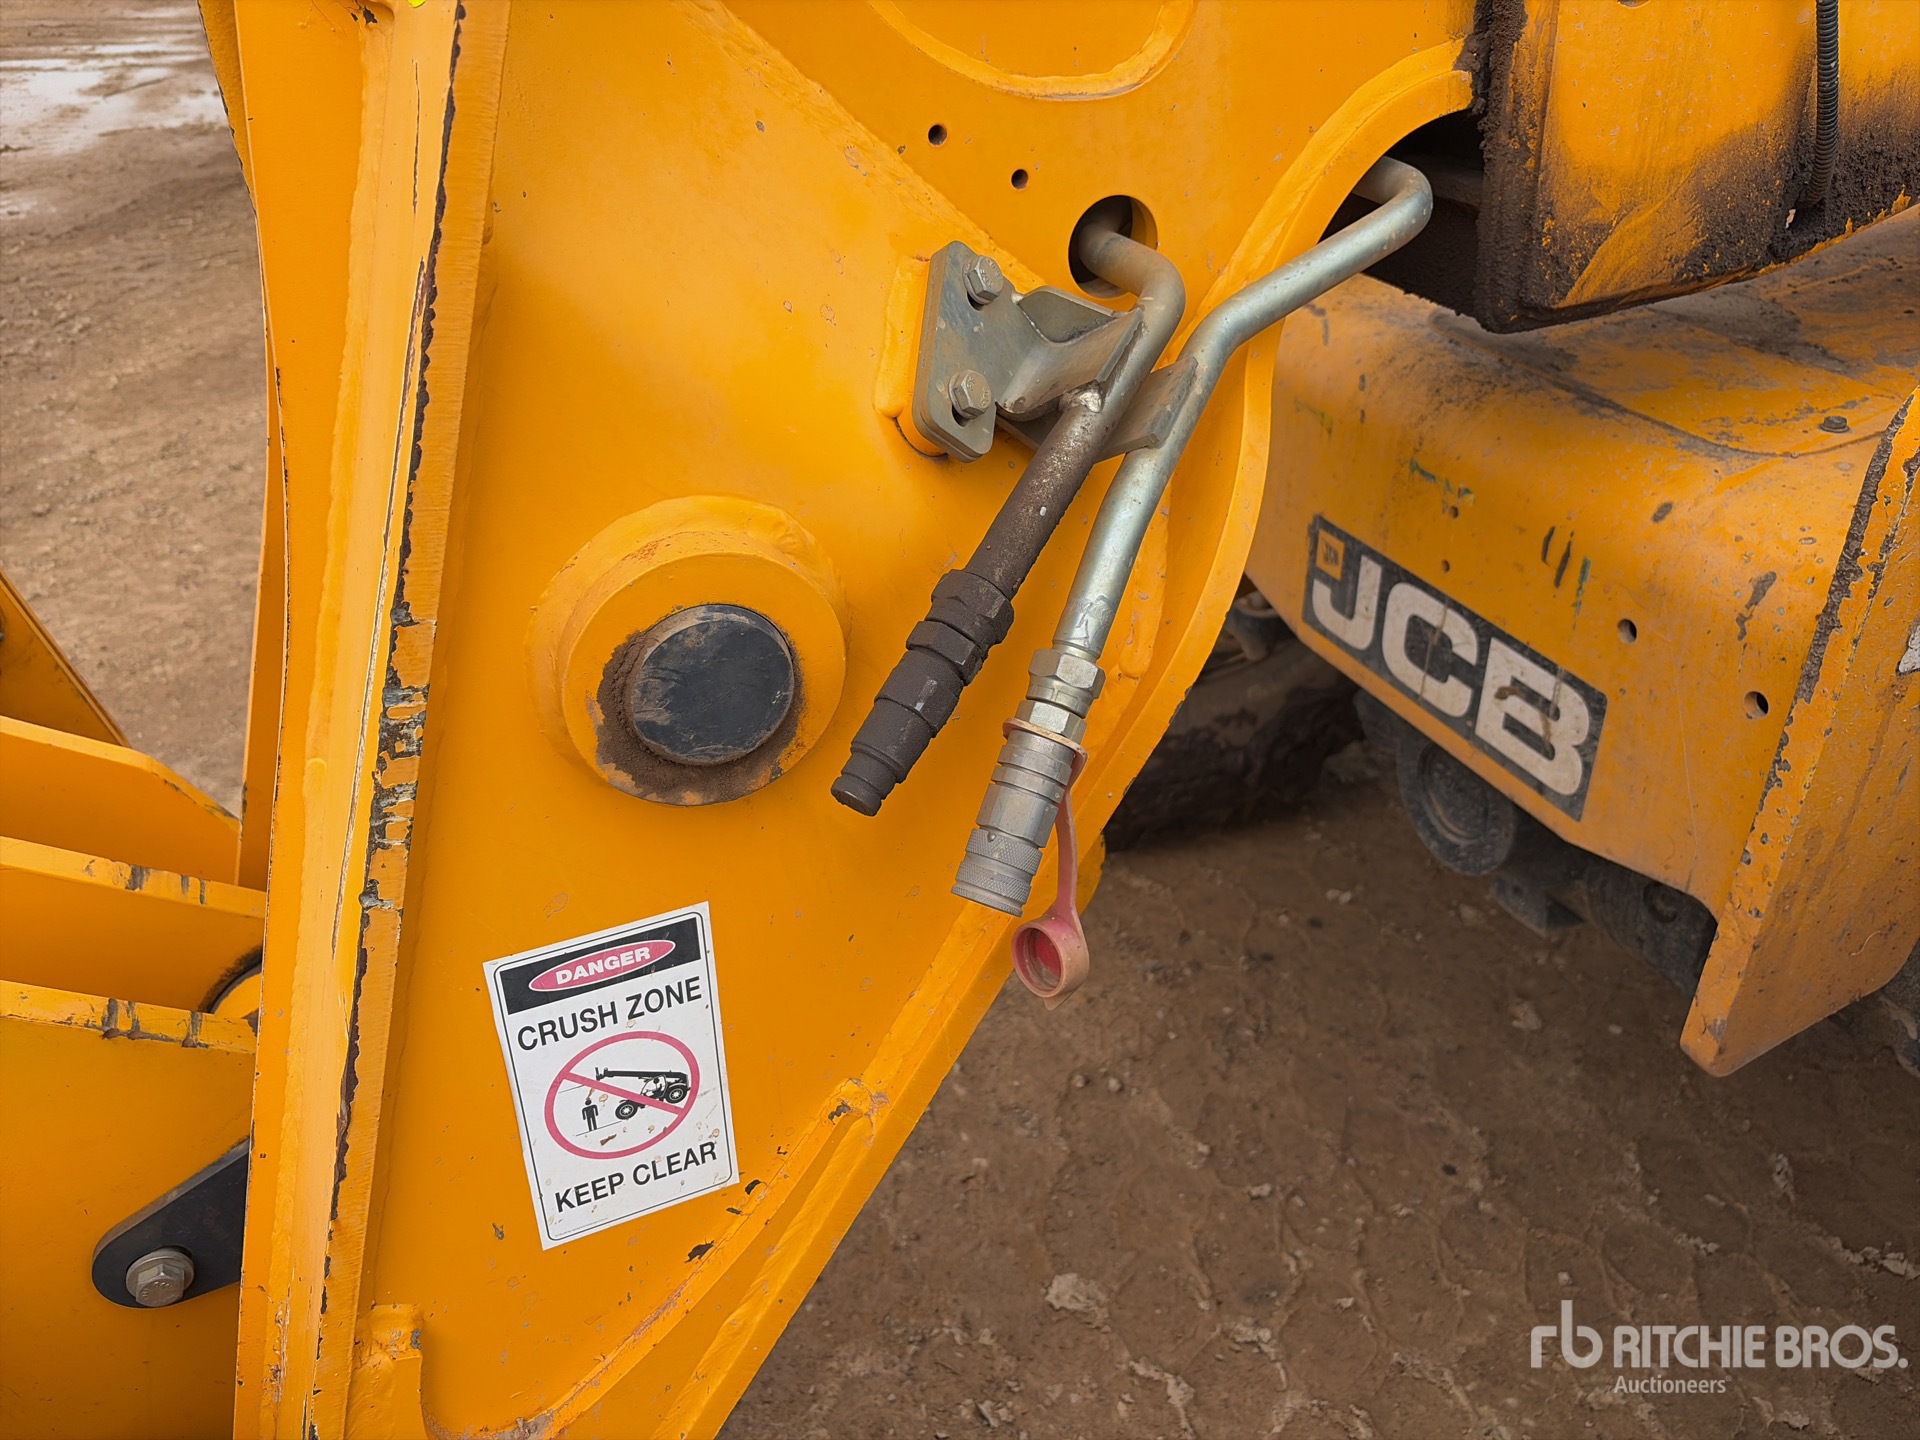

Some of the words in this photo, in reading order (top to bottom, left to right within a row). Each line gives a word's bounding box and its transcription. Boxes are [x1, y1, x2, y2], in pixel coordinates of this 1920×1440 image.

[1312, 554, 1590, 796] JCB
[556, 946, 651, 985] DANGER
[517, 1001, 618, 1050] CRUSH
[625, 976, 702, 1020] ZONE
[555, 1172, 624, 1213] KEEP
[632, 1141, 717, 1186] CLEAR
